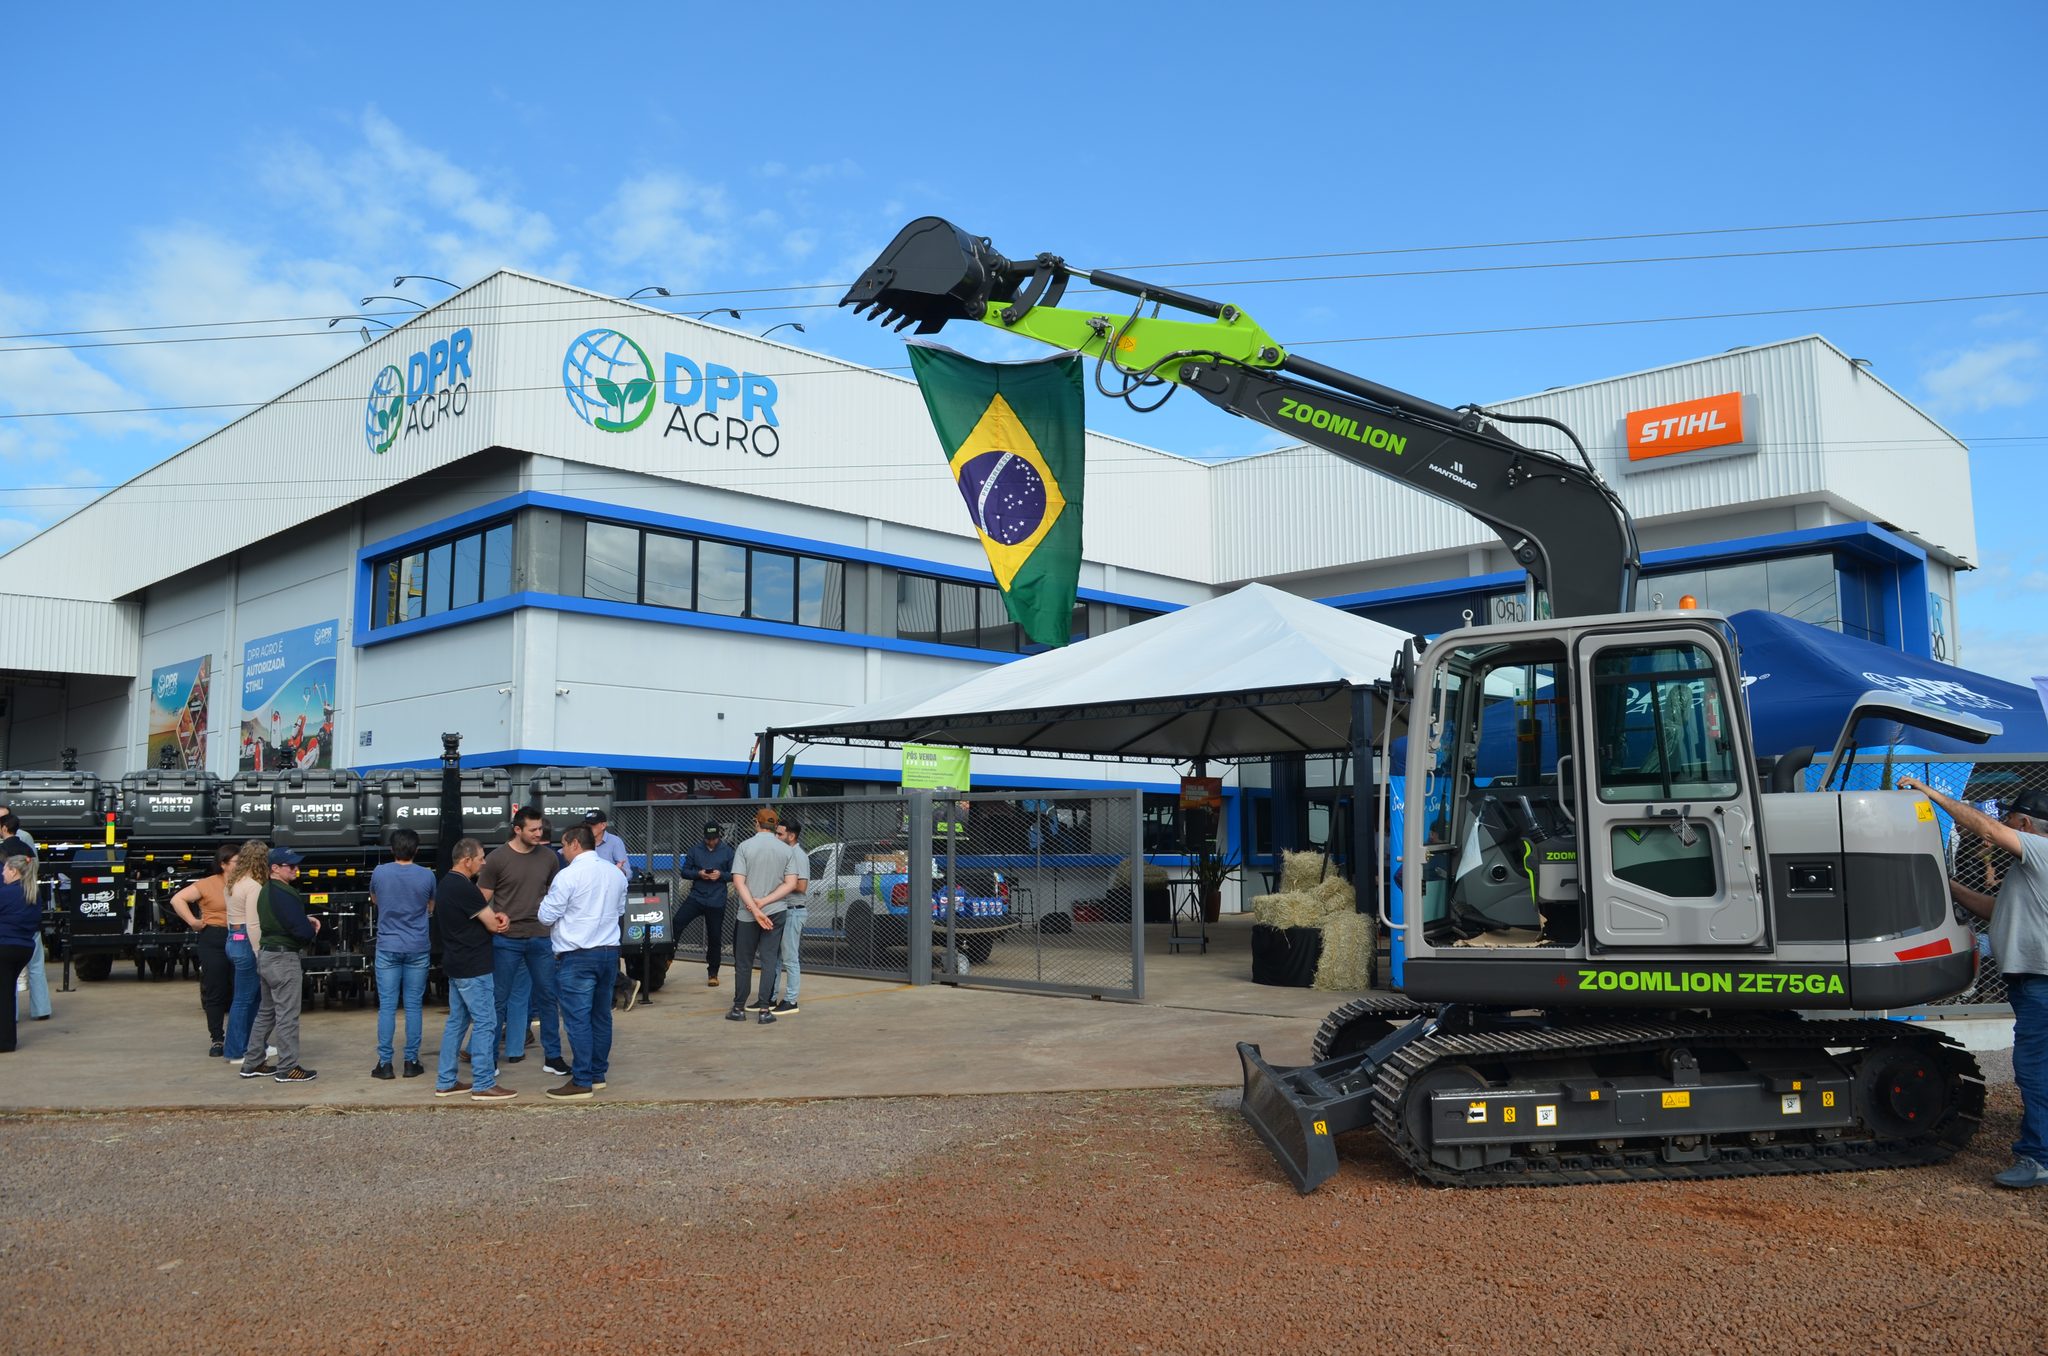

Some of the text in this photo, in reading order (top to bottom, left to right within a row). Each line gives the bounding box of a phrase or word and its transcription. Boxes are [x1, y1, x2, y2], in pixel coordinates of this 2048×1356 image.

[406, 327, 473, 407] DPR
[664, 351, 779, 427] DPR
[404, 382, 469, 440] AGRO
[663, 405, 779, 457] AGRO
[1277, 398, 1408, 456] ZOOMLION
[1640, 410, 1726, 443] STIHL
[981, 453, 1011, 497] PROGRESSO
[1428, 463, 1478, 490] MANTOMAC
[248, 647, 260, 661] DPR
[261, 642, 278, 657] AGRO
[246, 657, 285, 677] AUTORIZADA
[165, 672, 178, 688] DPR
[919, 752, 937, 761] VENDA
[149, 796, 193, 805] PLANTIO
[152, 805, 190, 813] DIRETO
[292, 804, 343, 813] PLANTIO
[295, 813, 340, 822] DIRETO
[413, 806, 502, 816] HID PLUS
[544, 807, 568, 815] SHE
[1546, 852, 1576, 860] ZOOM
[92, 902, 109, 910] DPR
[1578, 970, 1845, 994] ZOOMLION ZE75GA
